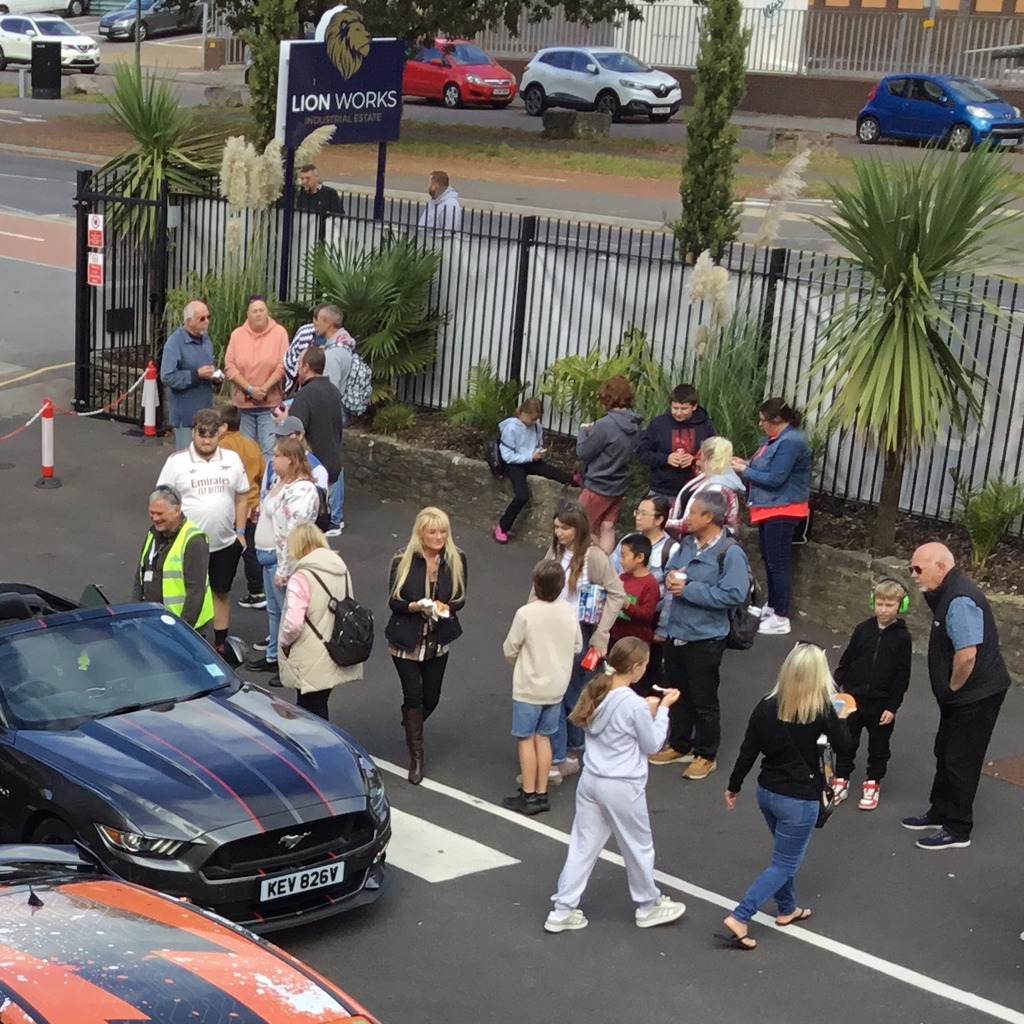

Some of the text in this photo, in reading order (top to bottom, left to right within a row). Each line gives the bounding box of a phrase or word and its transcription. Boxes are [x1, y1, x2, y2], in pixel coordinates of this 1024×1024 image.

[292, 90, 397, 112] LION WORKS
[304, 112, 382, 125] INDUSTRIAL ESTATE
[191, 477, 231, 488] Emirates
[267, 865, 339, 899] KEV 826V
